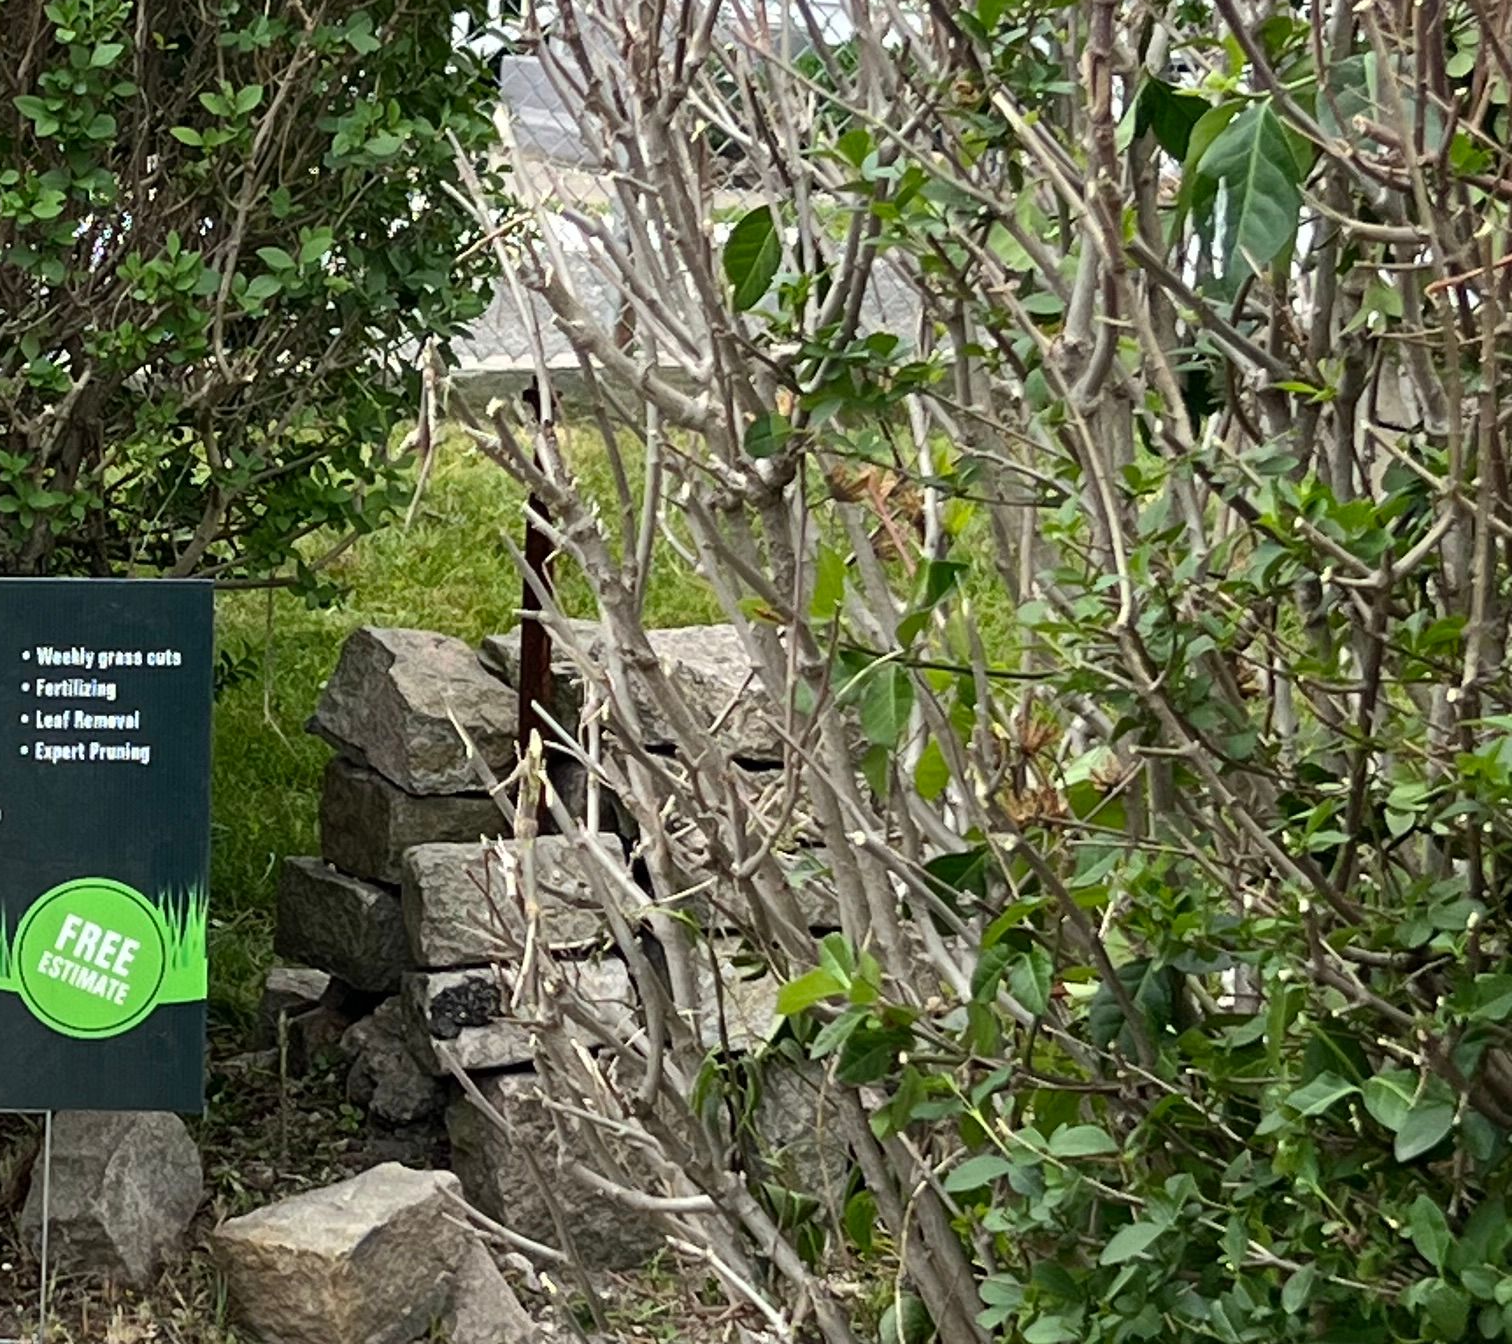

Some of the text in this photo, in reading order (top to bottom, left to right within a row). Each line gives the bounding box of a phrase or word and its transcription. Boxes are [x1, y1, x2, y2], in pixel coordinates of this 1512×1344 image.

[36, 647, 182, 669] Weekly grass cuts
[36, 678, 117, 701] Fertilizing
[36, 710, 140, 729] Leaf Removal
[35, 742, 150, 764] Expert Pruning
[55, 913, 141, 977] FREE
[37, 950, 130, 1006] ESTIMATE
